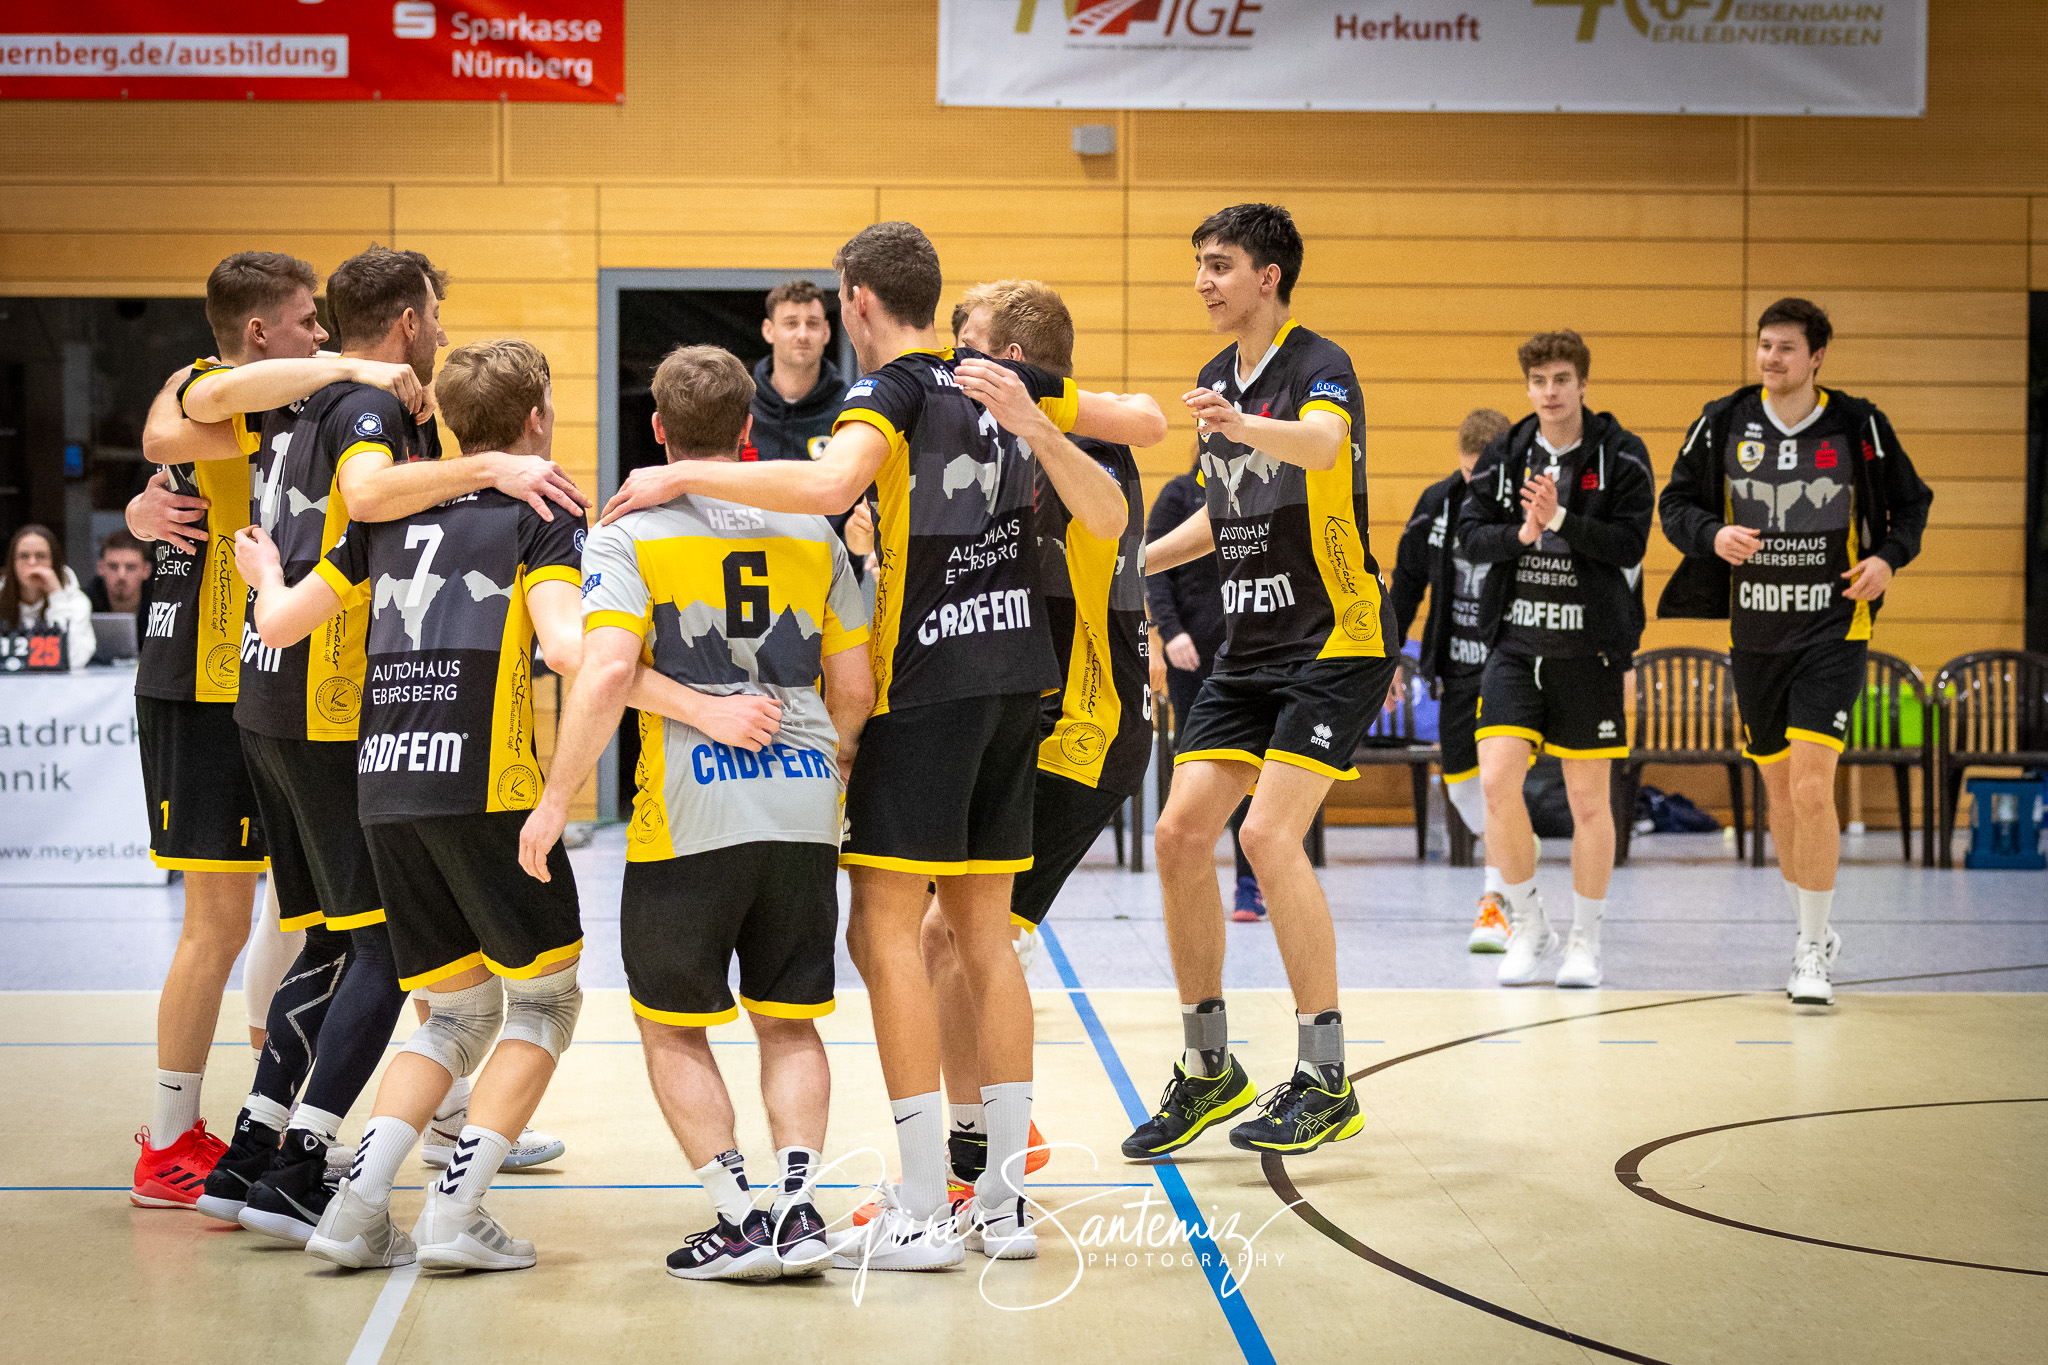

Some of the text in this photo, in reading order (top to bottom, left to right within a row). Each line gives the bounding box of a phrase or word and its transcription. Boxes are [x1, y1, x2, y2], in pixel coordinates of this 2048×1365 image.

[1334, 12, 1480, 41] Herkunft
[1735, 3, 1883, 22] EISENBAHN
[450, 11, 602, 46] Sparkasse
[1651, 25, 1882, 46] ERLEBNISREISEN
[0, 40, 338, 72] ernberg.de/ausbildung
[452, 50, 593, 87] Nürnberg
[1777, 439, 1798, 470] 8
[706, 508, 765, 530] HESS
[403, 523, 445, 608] 7
[214, 534, 236, 638] Kreitmaier
[721, 550, 771, 639] 6
[1739, 581, 1832, 612] CADFEM
[917, 588, 1031, 646] CADFEM
[28, 635, 60, 666] 25
[372, 660, 461, 682] AUTOHAUS
[691, 741, 831, 785] CADFEM
[160, 800, 170, 830] 1
[240, 816, 250, 847] 1
